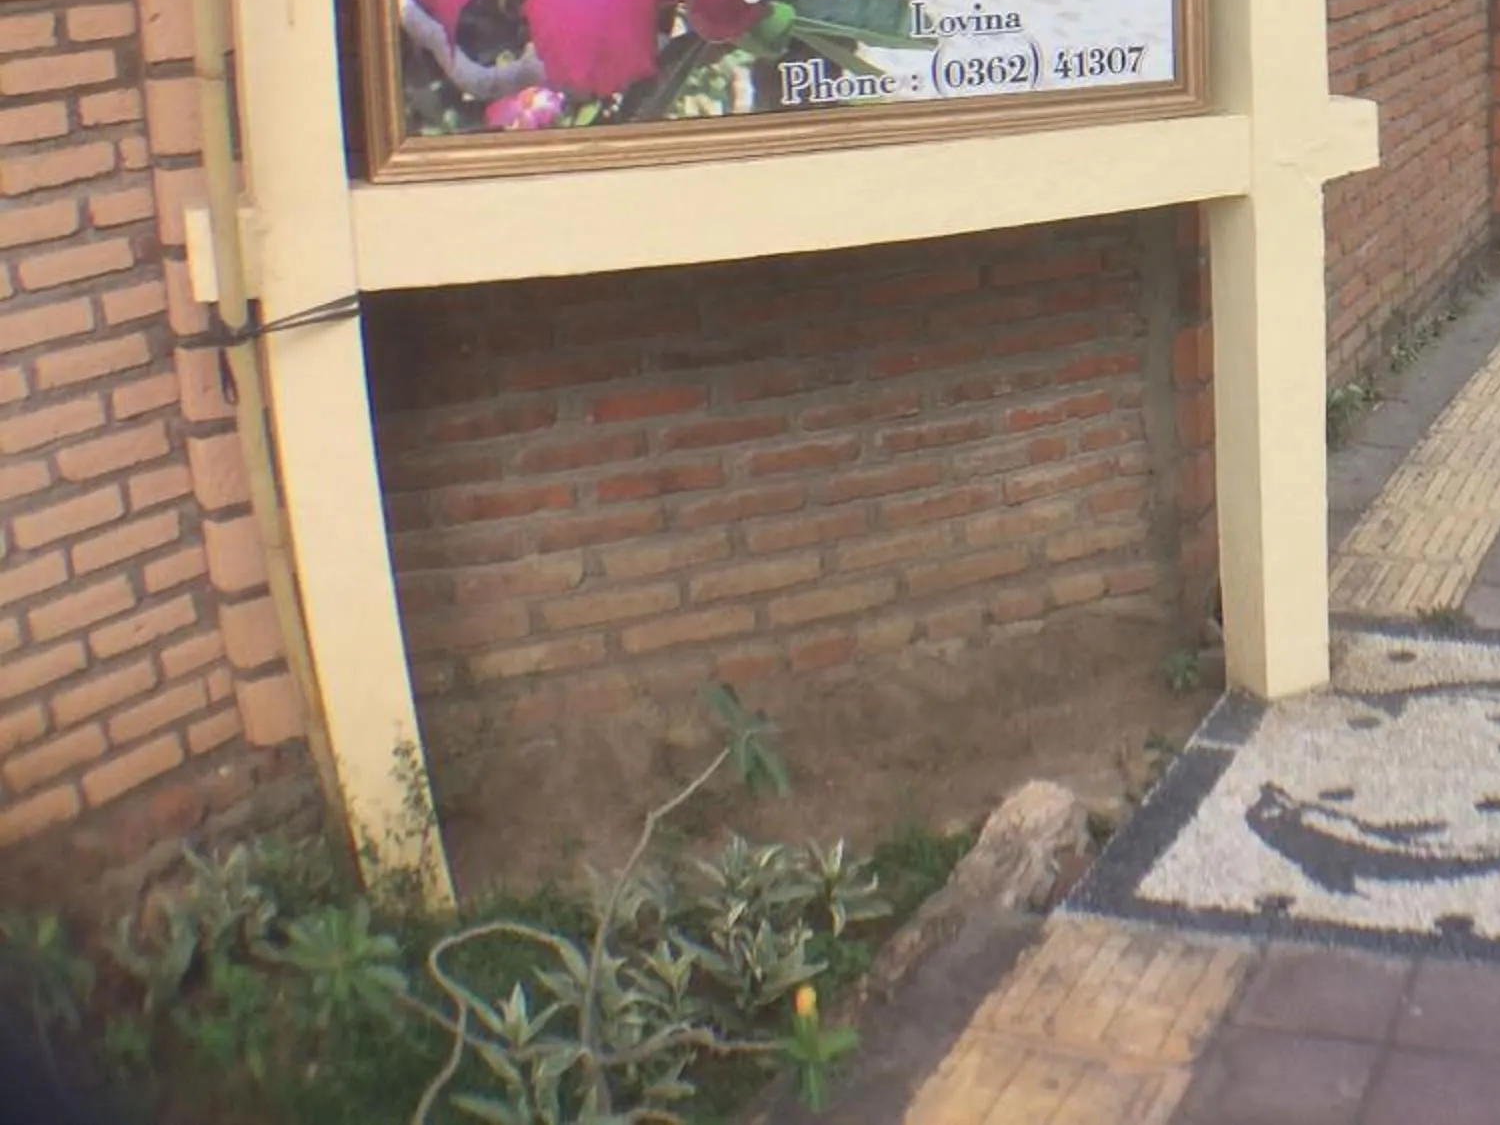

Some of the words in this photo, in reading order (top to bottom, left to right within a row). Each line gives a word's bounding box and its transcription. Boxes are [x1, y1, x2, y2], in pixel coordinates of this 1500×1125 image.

[912, 2, 1022, 38] Lovina
[781, 59, 897, 104] Phone
[931, 42, 1040, 96] (0362)
[1053, 46, 1145, 80] 41307
